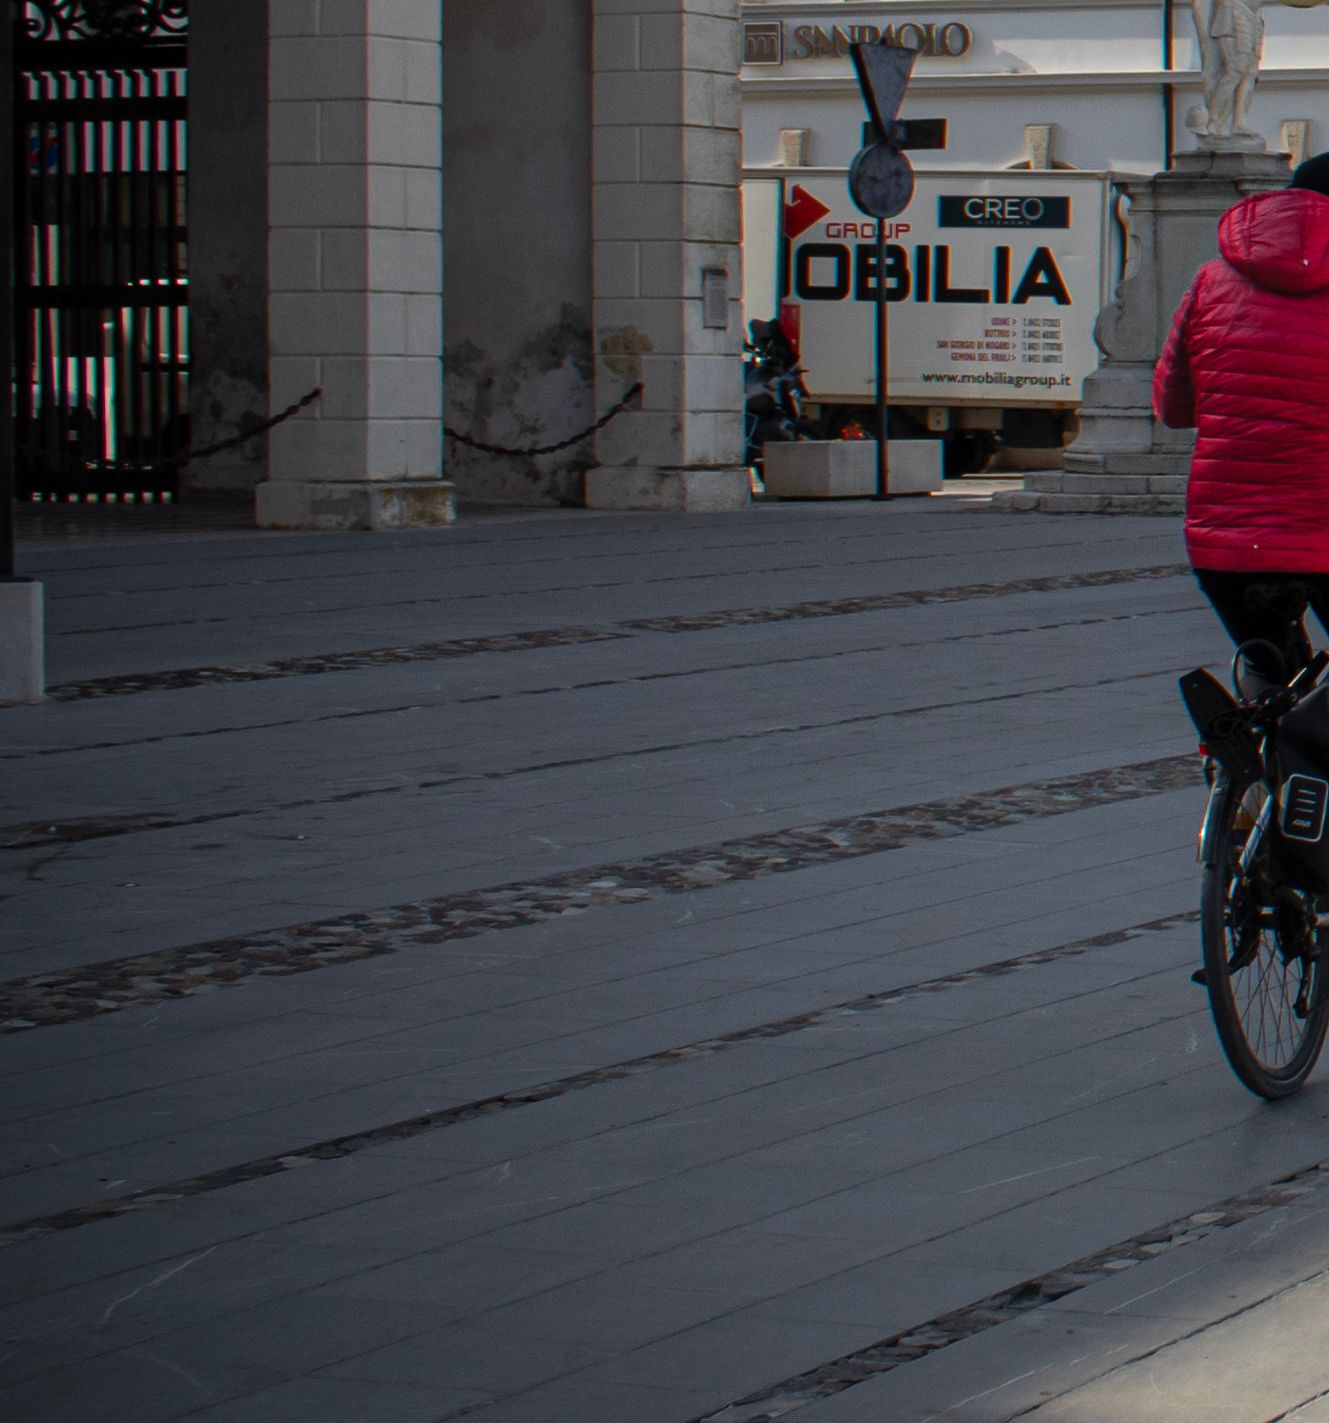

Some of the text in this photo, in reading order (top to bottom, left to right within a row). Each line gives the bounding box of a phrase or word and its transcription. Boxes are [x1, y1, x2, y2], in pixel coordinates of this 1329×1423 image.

[793, 23, 971, 58] SANPAOLO
[964, 197, 1045, 221] CREO
[781, 242, 1072, 306] OBILIA
[922, 372, 1073, 388] www.mobiliagroup.it
